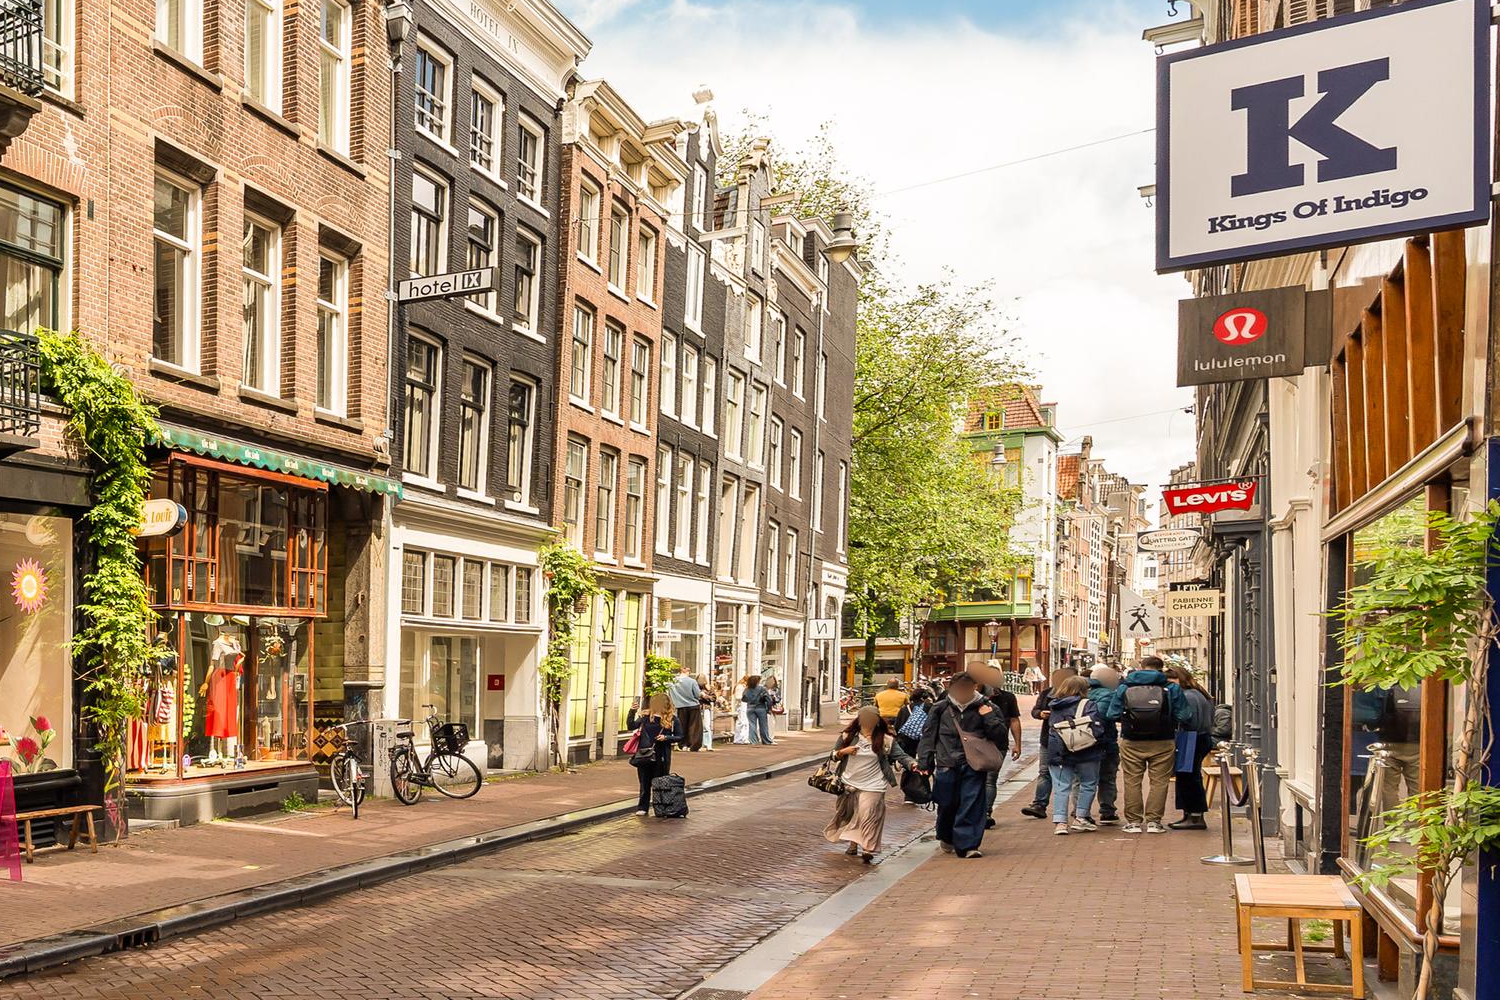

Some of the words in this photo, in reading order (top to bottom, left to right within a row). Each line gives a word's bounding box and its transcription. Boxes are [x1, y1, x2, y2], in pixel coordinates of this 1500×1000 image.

[470, 2, 500, 39] HOTEL
[508, 35, 519, 54] IX
[1231, 57, 1397, 198] K
[1208, 211, 1286, 234] Kings
[1293, 199, 1328, 219] Of
[1333, 187, 1428, 213] Indigo
[409, 275, 457, 297] hotel
[463, 272, 480, 288] IX
[1195, 353, 1286, 371] lululemon
[1172, 596, 1214, 604] FABIENNE
[1172, 602, 1214, 610] CHAPOT
